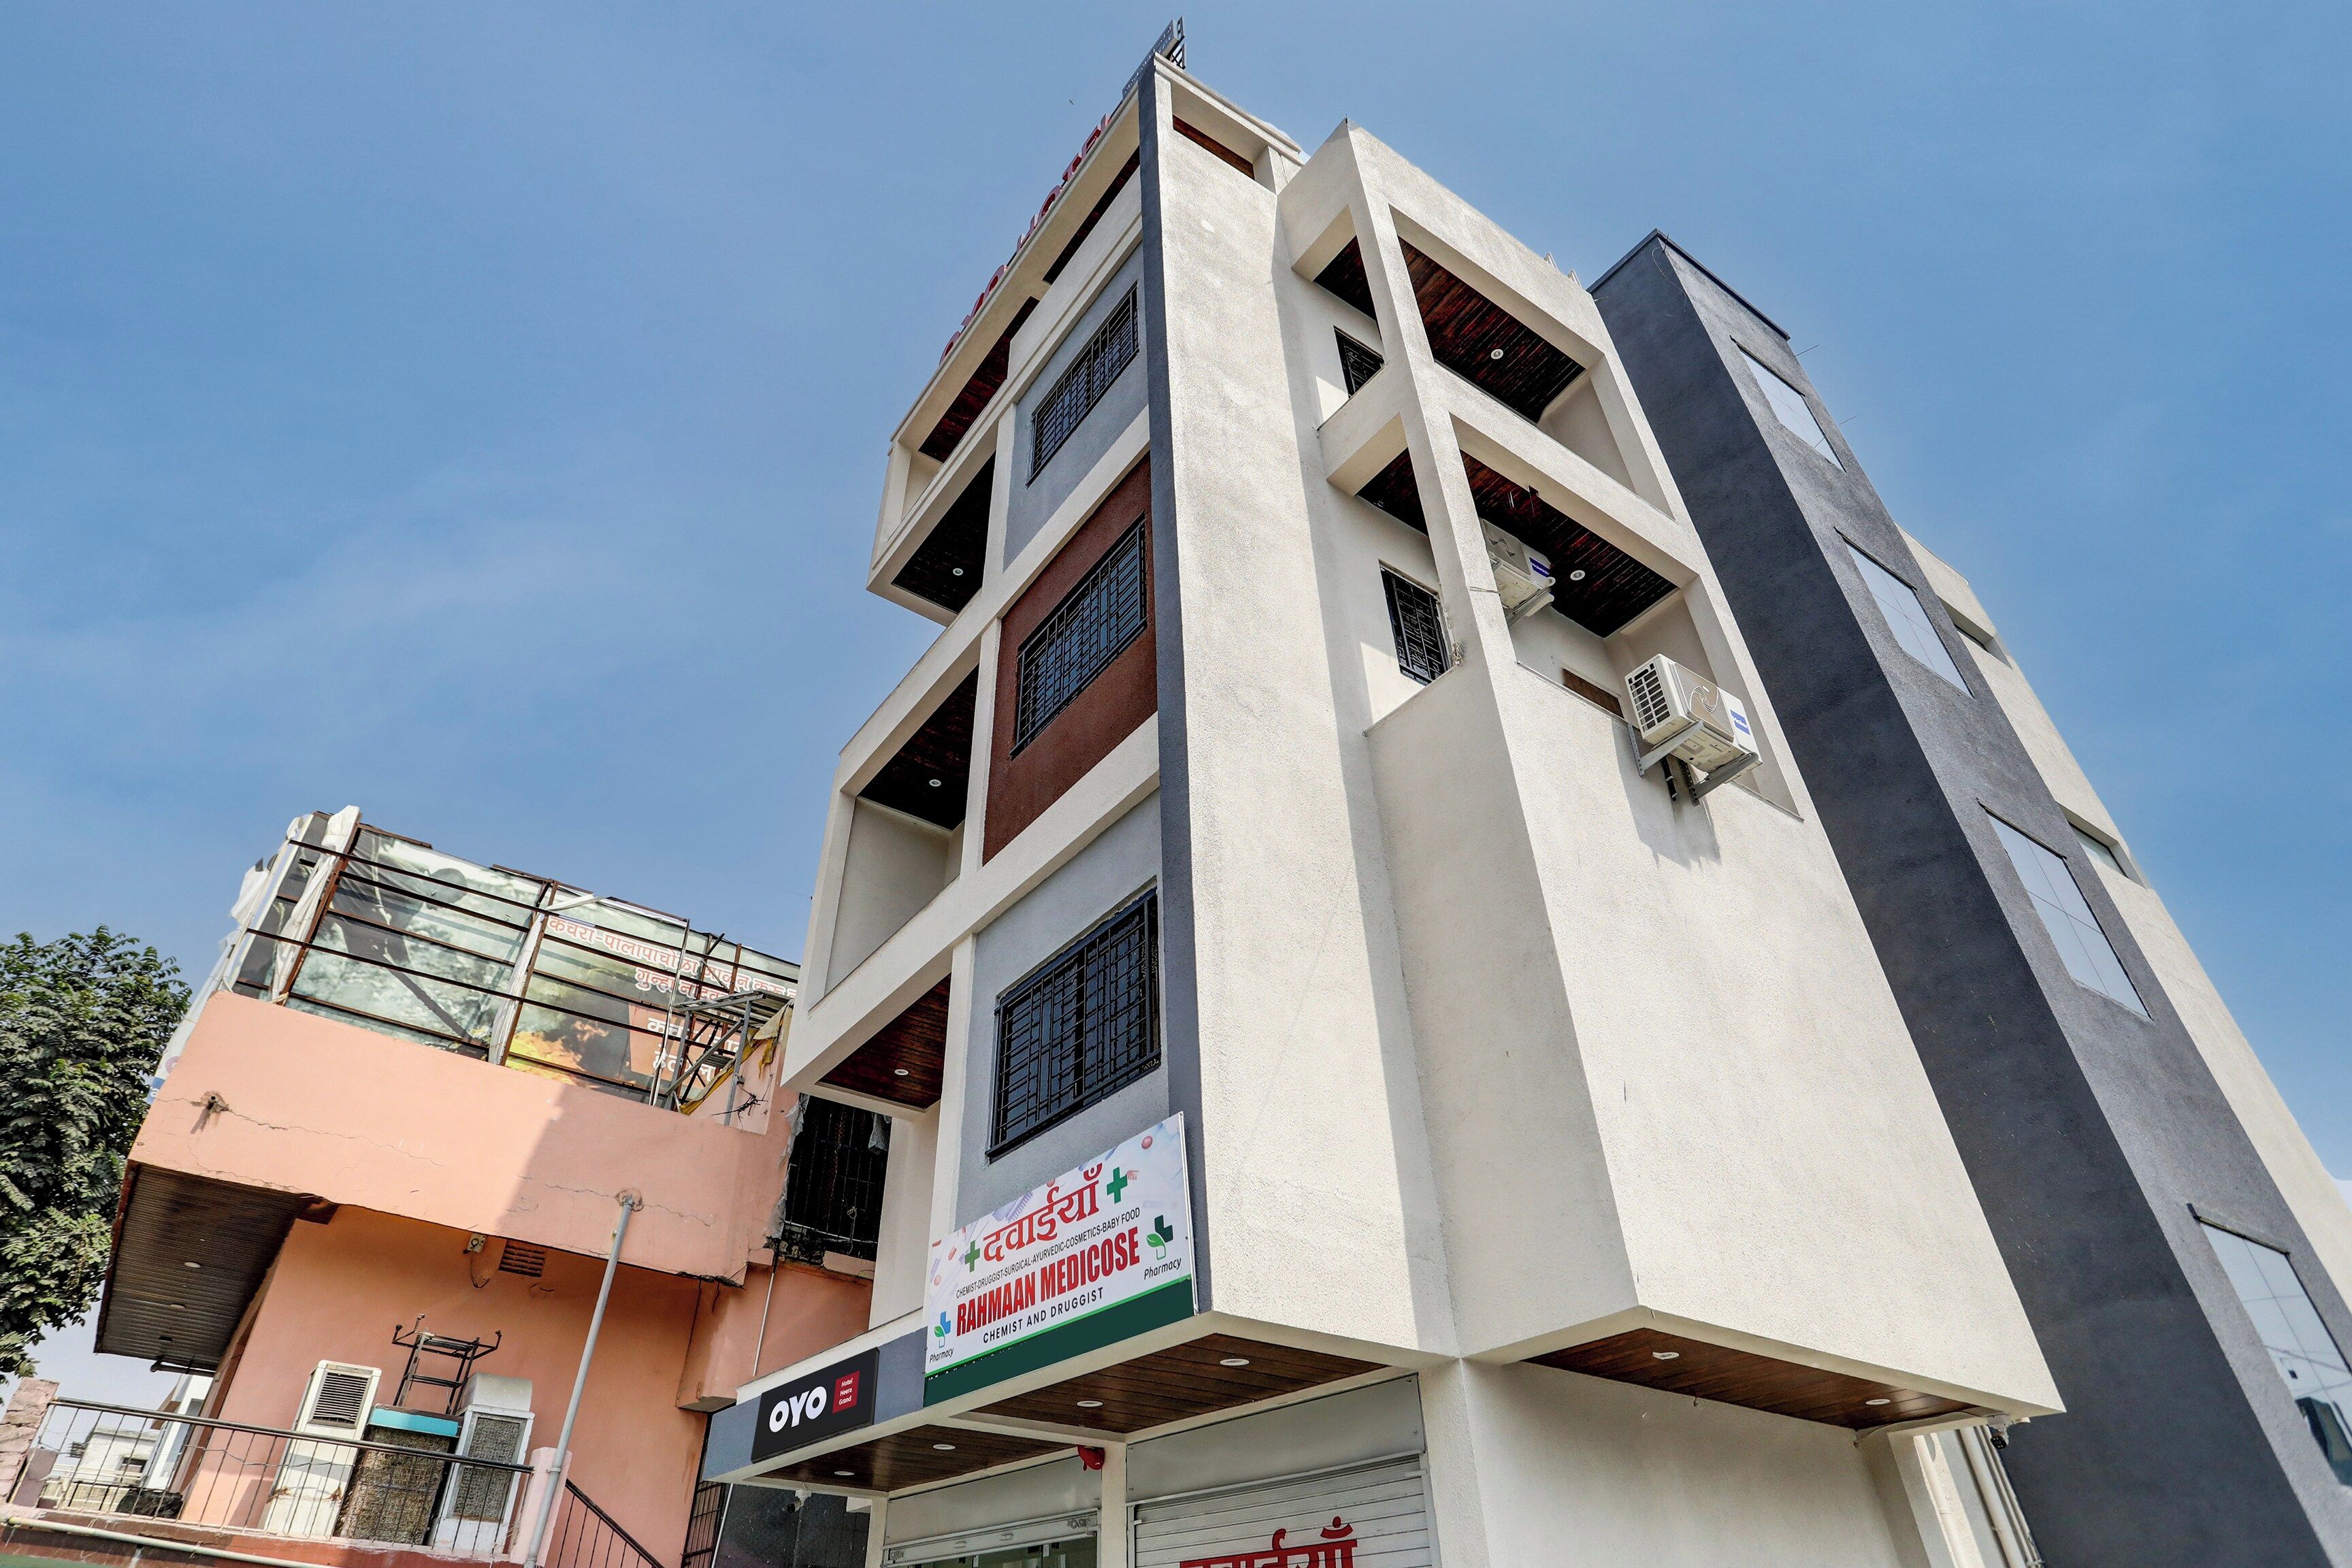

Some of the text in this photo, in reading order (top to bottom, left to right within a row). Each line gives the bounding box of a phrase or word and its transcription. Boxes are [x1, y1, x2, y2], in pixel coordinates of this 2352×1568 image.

[983, 1162, 1102, 1262] दवाईयाँ
[1121, 1207, 1141, 1224] FOOD
[1144, 1258, 1181, 1280] Pharmacy
[956, 1226, 1140, 1337] RAHMAAN MEDICOSE
[983, 1287, 1104, 1343] CHEMIST AND DRUGGIST
[929, 1348, 954, 1363] Pharmacy
[840, 1388, 853, 1396] Heera
[841, 1377, 853, 1388] Hotel
[769, 1386, 827, 1433] OYO
[838, 1395, 852, 1405] Grand
